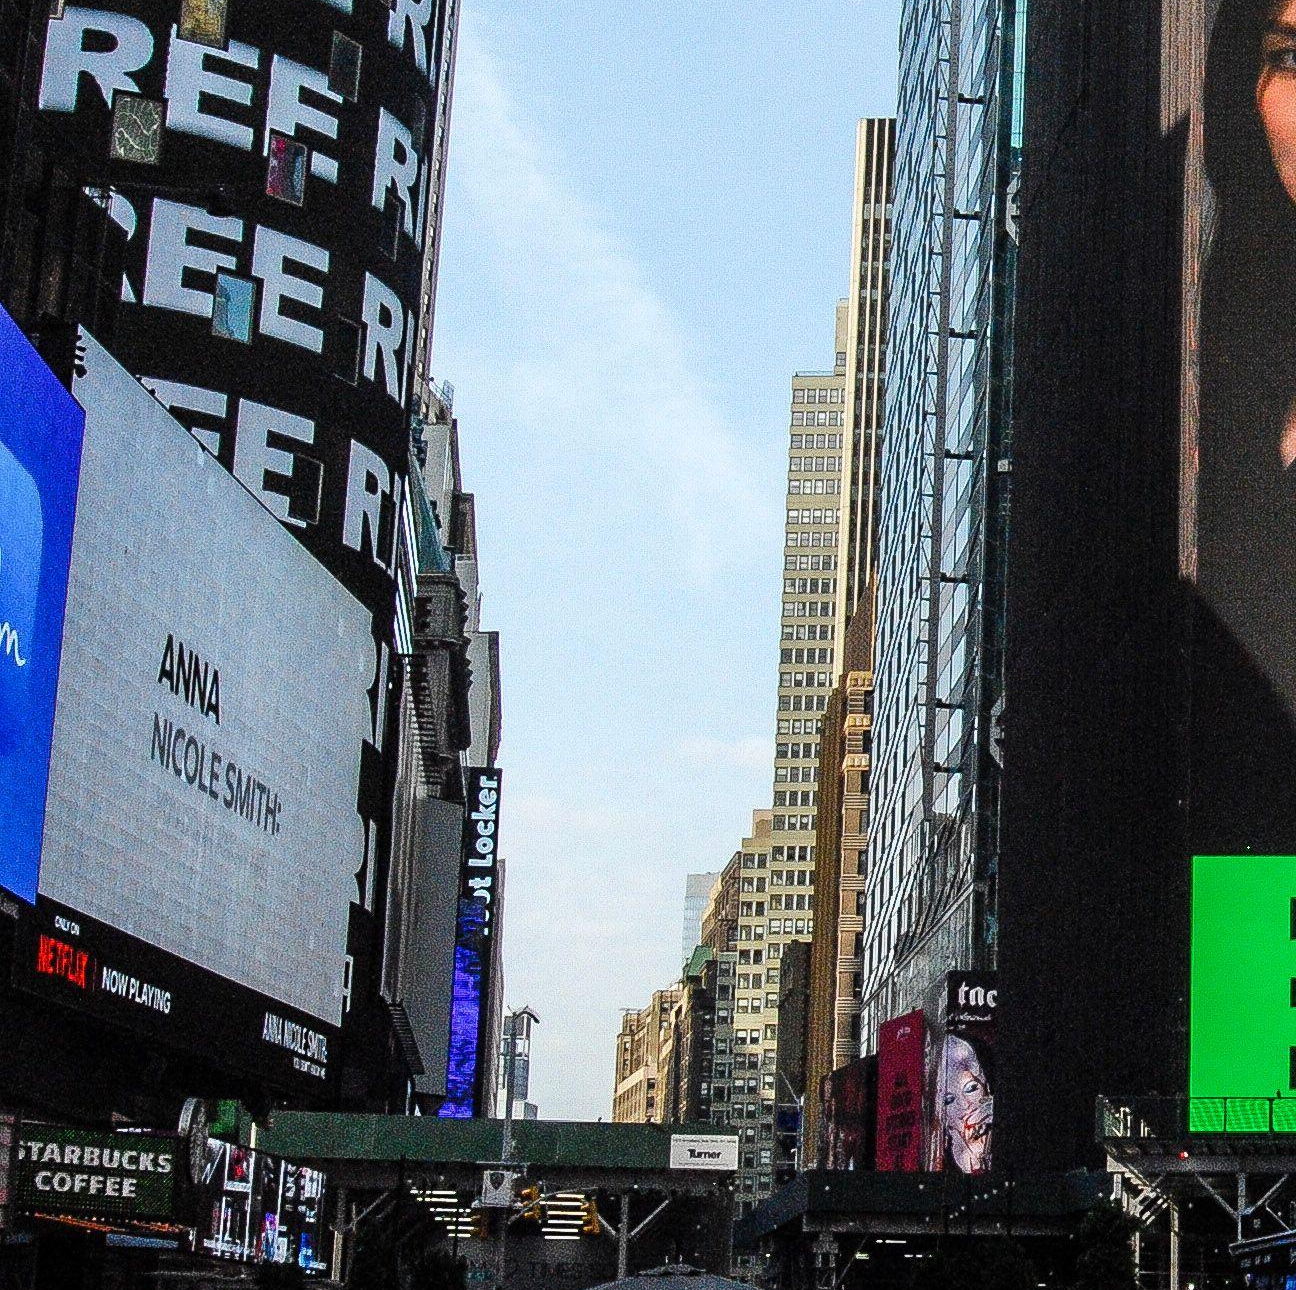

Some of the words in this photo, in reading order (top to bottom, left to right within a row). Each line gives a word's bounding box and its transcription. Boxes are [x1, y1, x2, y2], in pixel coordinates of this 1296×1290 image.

[158, 633, 220, 726] ANNA
[151, 712, 222, 801] NICOLE
[36, 934, 90, 990] NETFLIX
[102, 967, 129, 997] NOW
[129, 977, 173, 1015] PLAYING
[687, 1148, 722, 1159] Turner
[34, 1170, 138, 1198] COFFEE
